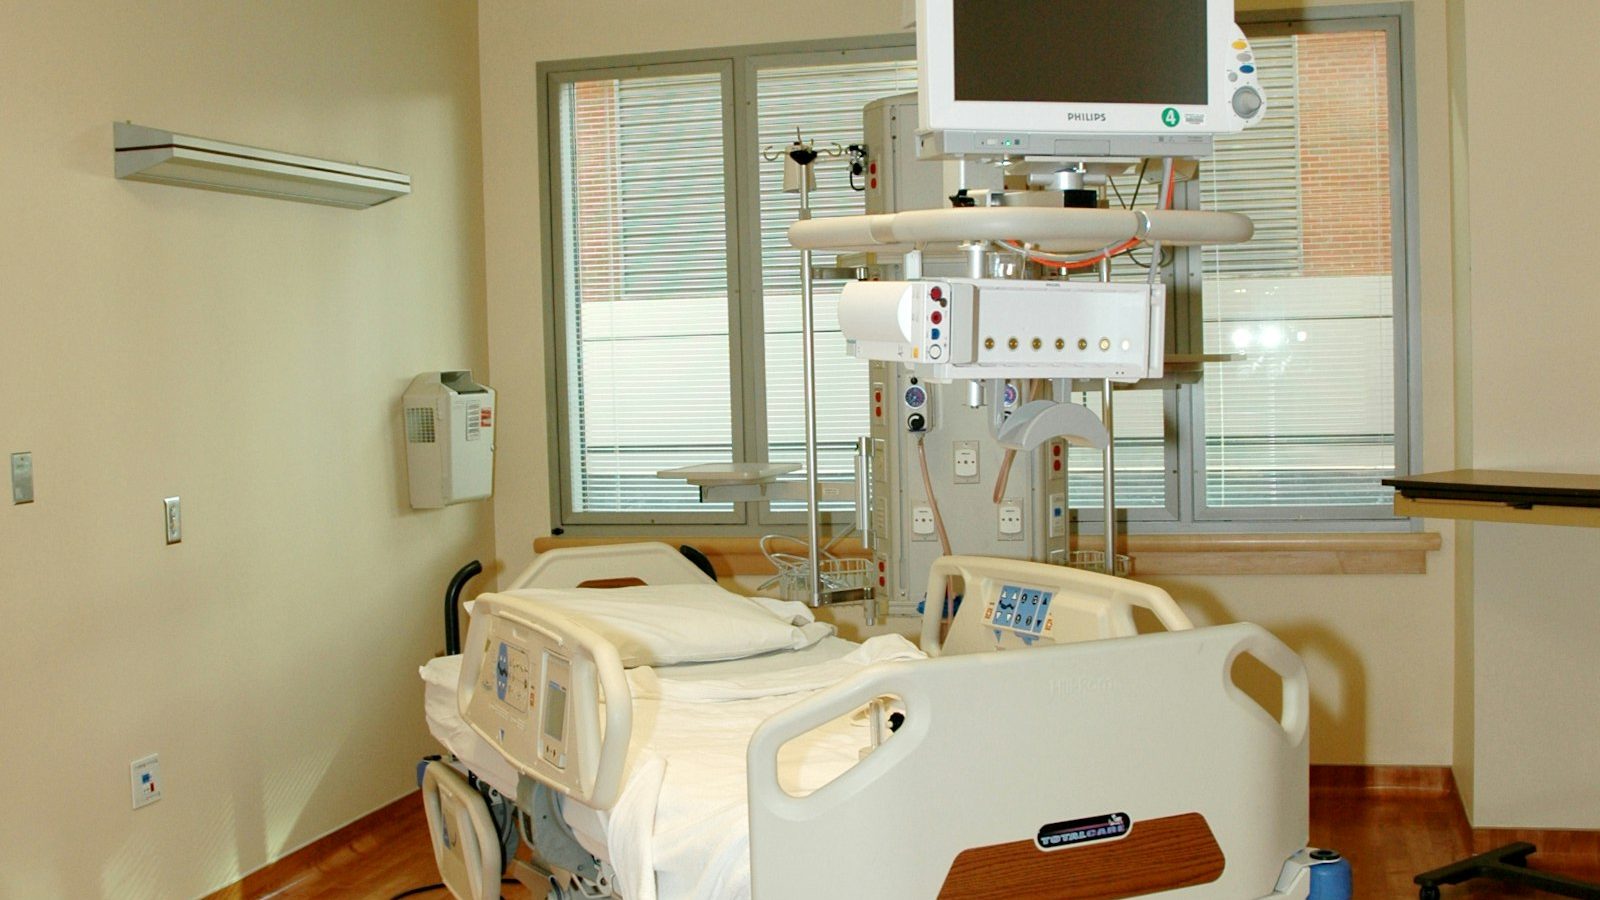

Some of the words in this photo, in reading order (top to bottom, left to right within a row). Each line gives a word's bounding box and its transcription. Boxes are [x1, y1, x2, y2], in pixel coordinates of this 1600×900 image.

[1067, 112, 1107, 122] PHILIPS
[1166, 110, 1177, 125] 4
[1040, 825, 1125, 845] TOTALCARE
